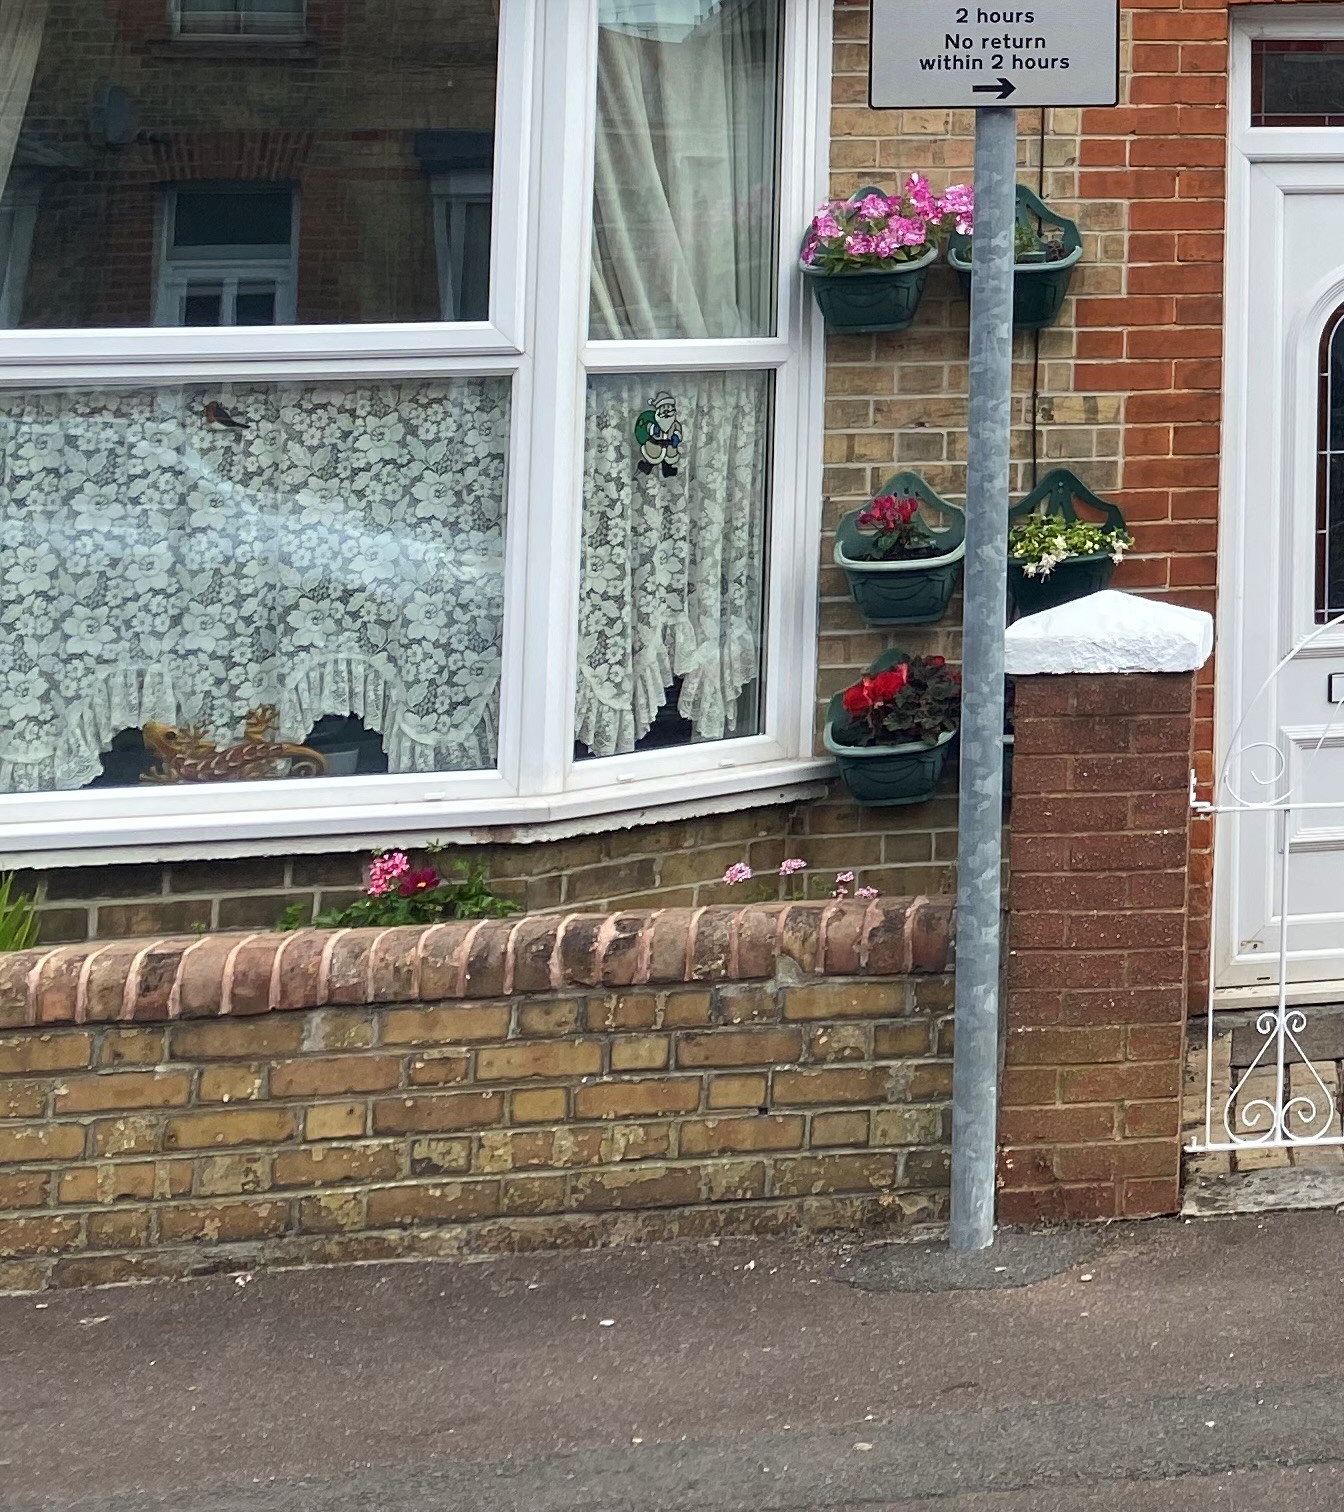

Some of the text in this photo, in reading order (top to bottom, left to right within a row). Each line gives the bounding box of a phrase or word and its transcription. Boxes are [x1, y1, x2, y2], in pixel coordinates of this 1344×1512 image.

[956, 8, 1034, 23] 2 hours
[946, 34, 1045, 49] No return
[920, 54, 1069, 70] within 2 hours
